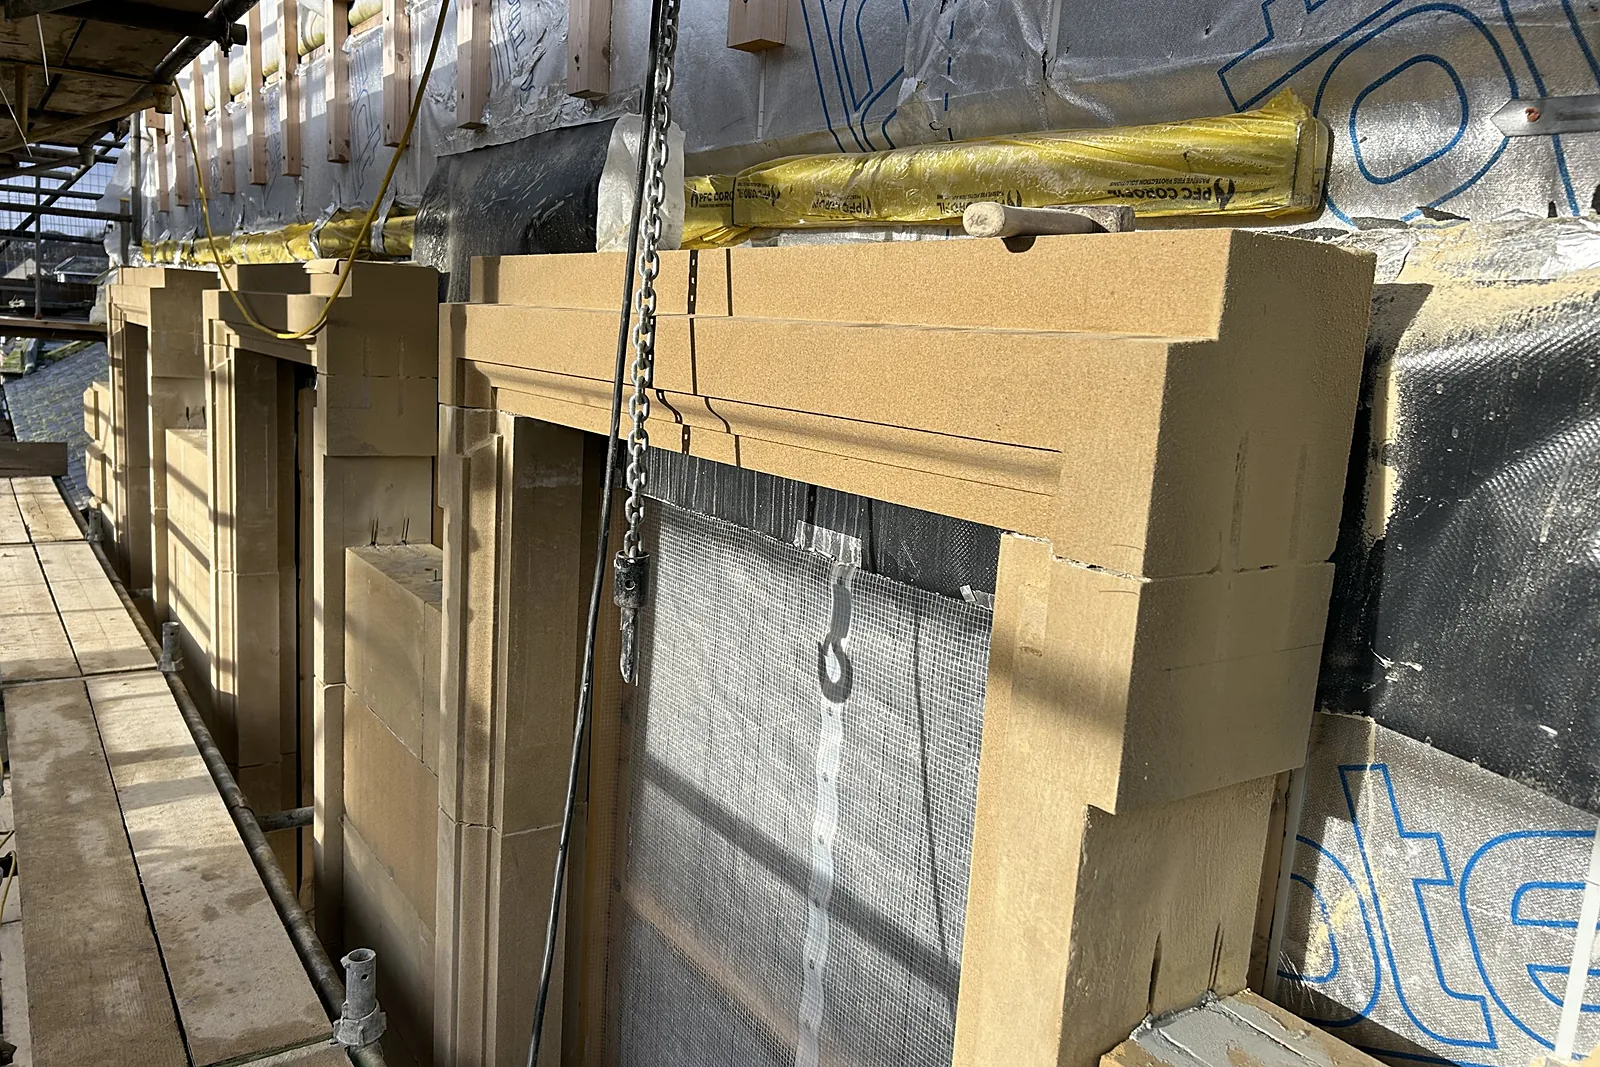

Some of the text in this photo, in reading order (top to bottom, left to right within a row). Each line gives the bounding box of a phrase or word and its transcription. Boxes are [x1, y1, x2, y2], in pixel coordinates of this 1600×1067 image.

[1139, 178, 1173, 186] PROTECTION
[1186, 177, 1211, 186] PASSIVE
[699, 192, 712, 202] PFC
[1181, 187, 1212, 201] PFC
